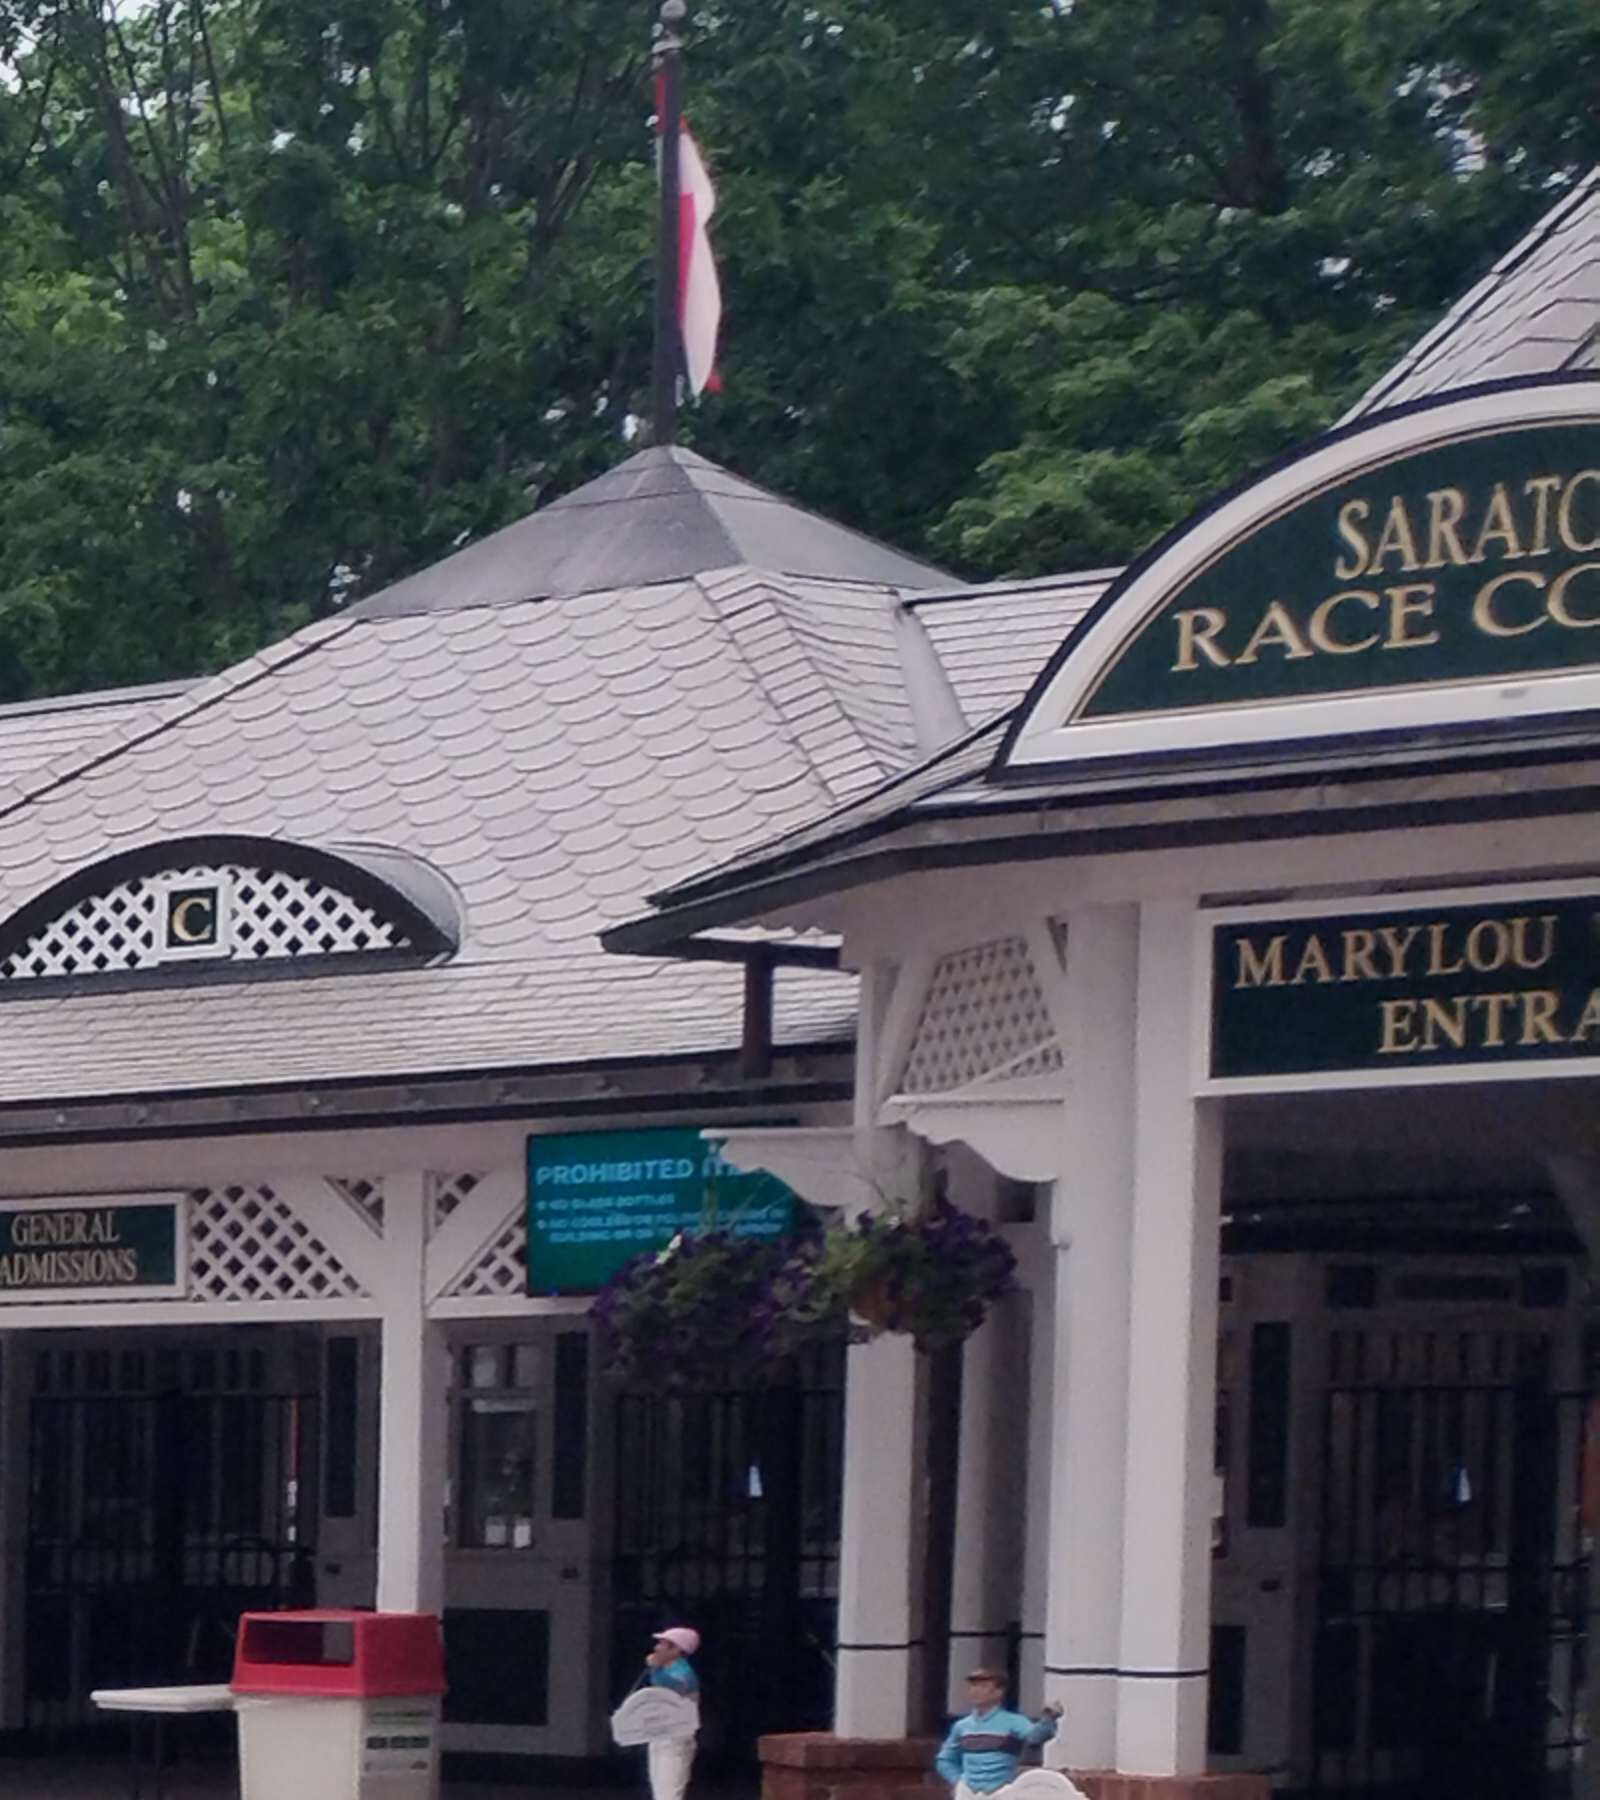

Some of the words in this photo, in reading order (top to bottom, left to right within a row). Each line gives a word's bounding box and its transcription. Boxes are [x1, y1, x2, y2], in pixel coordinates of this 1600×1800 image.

[1170, 582, 1440, 672] RACE
[171, 897, 212, 942] C
[1233, 915, 1557, 989] MARYLOU
[536, 1158, 695, 1186] PROHIBITED
[10, 1210, 120, 1247] GENERAL
